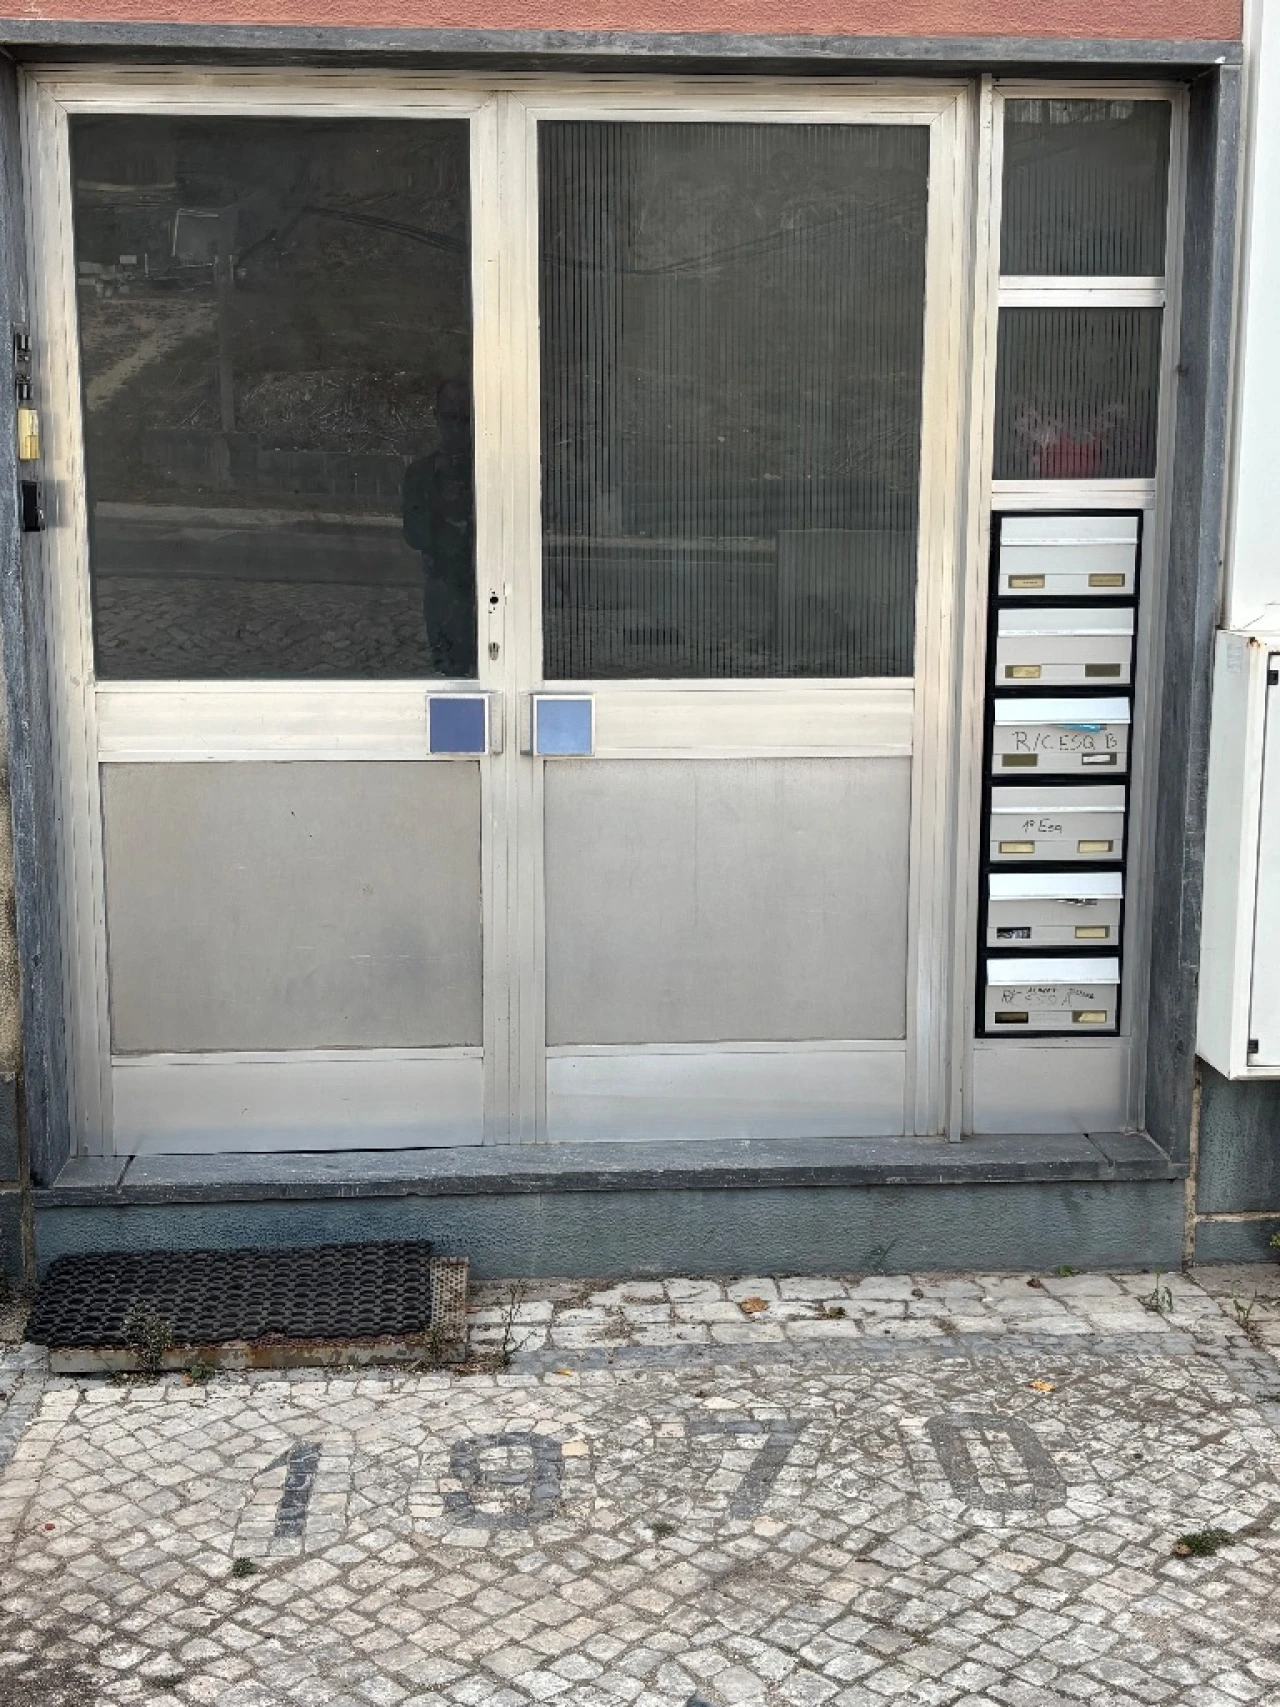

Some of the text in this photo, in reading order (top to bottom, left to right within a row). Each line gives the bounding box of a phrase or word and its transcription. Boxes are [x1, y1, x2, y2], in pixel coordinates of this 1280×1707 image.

[1059, 733, 1096, 751] ESQ
[1105, 733, 1118, 749] B
[250, 1411, 1068, 1538] 1970
